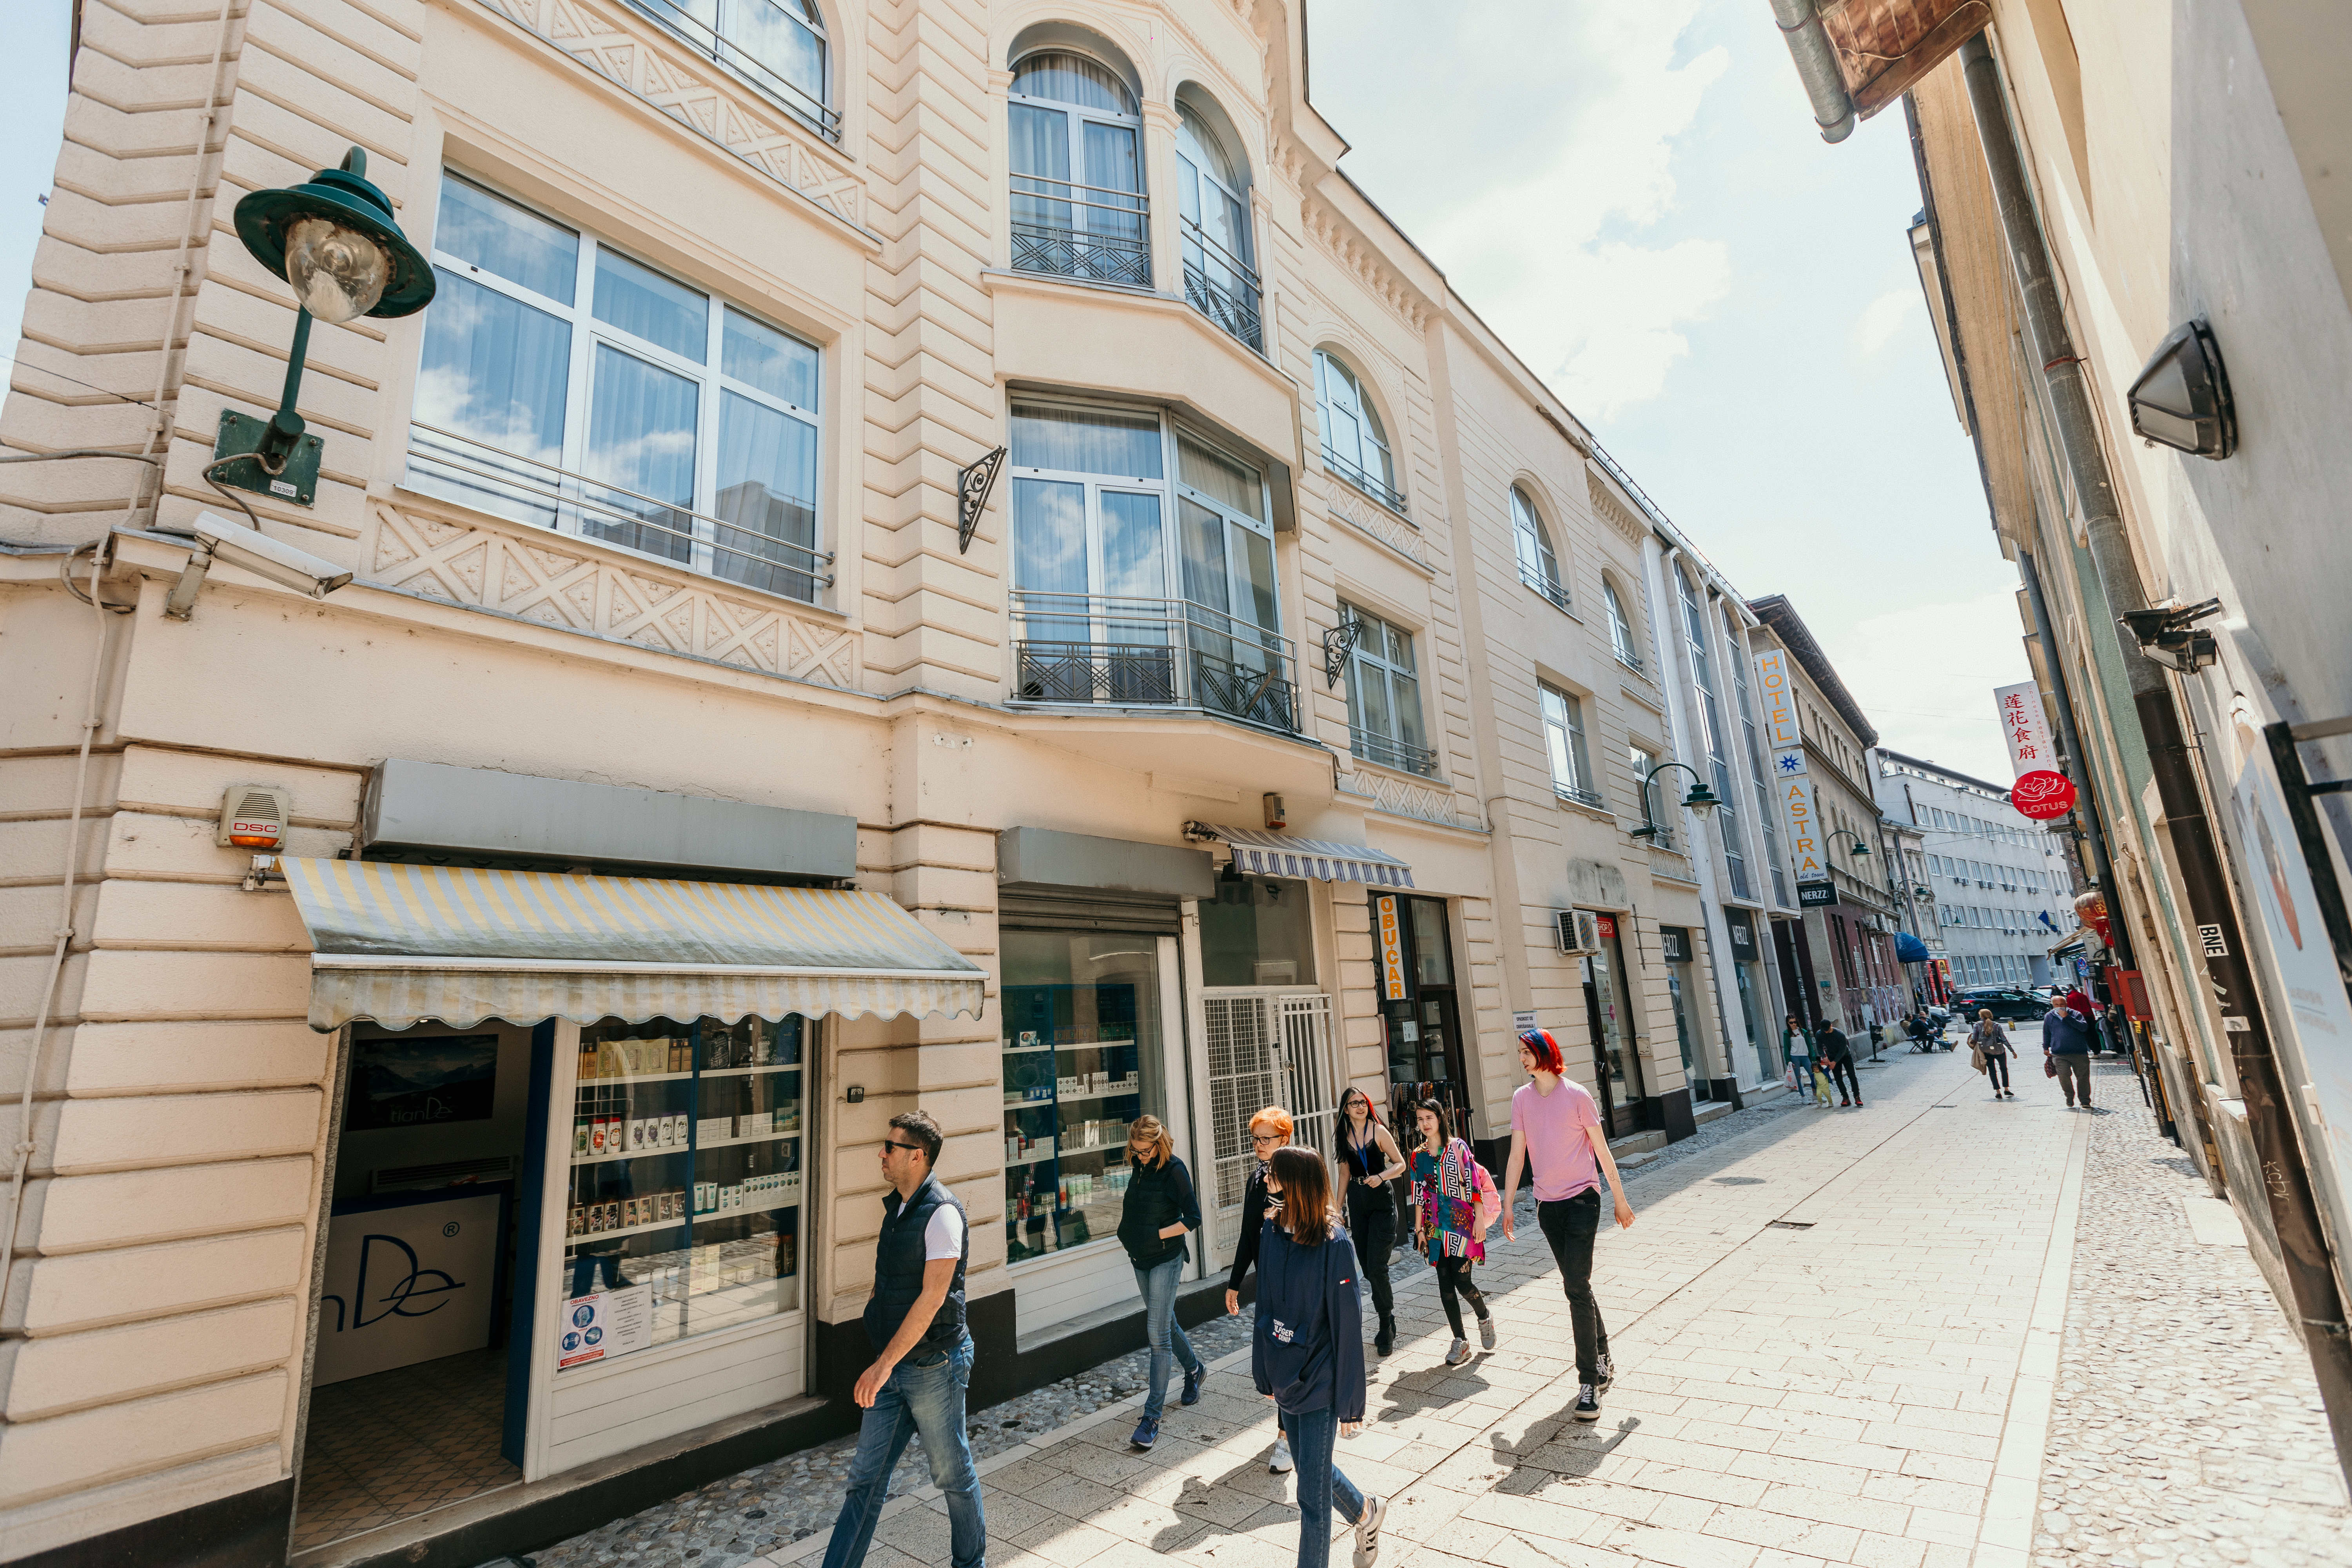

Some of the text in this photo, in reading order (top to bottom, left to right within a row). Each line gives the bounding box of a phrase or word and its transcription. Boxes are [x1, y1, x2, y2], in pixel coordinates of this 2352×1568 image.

[274, 486, 293, 495] 10309
[1761, 655, 1793, 742] HOTEL
[2004, 693, 2039, 761] 莲花食府
[2027, 685, 2051, 768] Chinese Restaurant
[2023, 801, 2068, 814] LOTUS
[234, 823, 277, 833] DSC
[1788, 785, 1820, 871] ASTRA
[1801, 890, 1828, 900] NERZZ
[1661, 934, 1679, 956] ERZZ
[1732, 925, 1749, 945] NERZZ
[2200, 926, 2225, 955] BNE
[1381, 898, 1403, 998] OBUĆAR
[570, 1294, 599, 1305] OBAVEZNO
